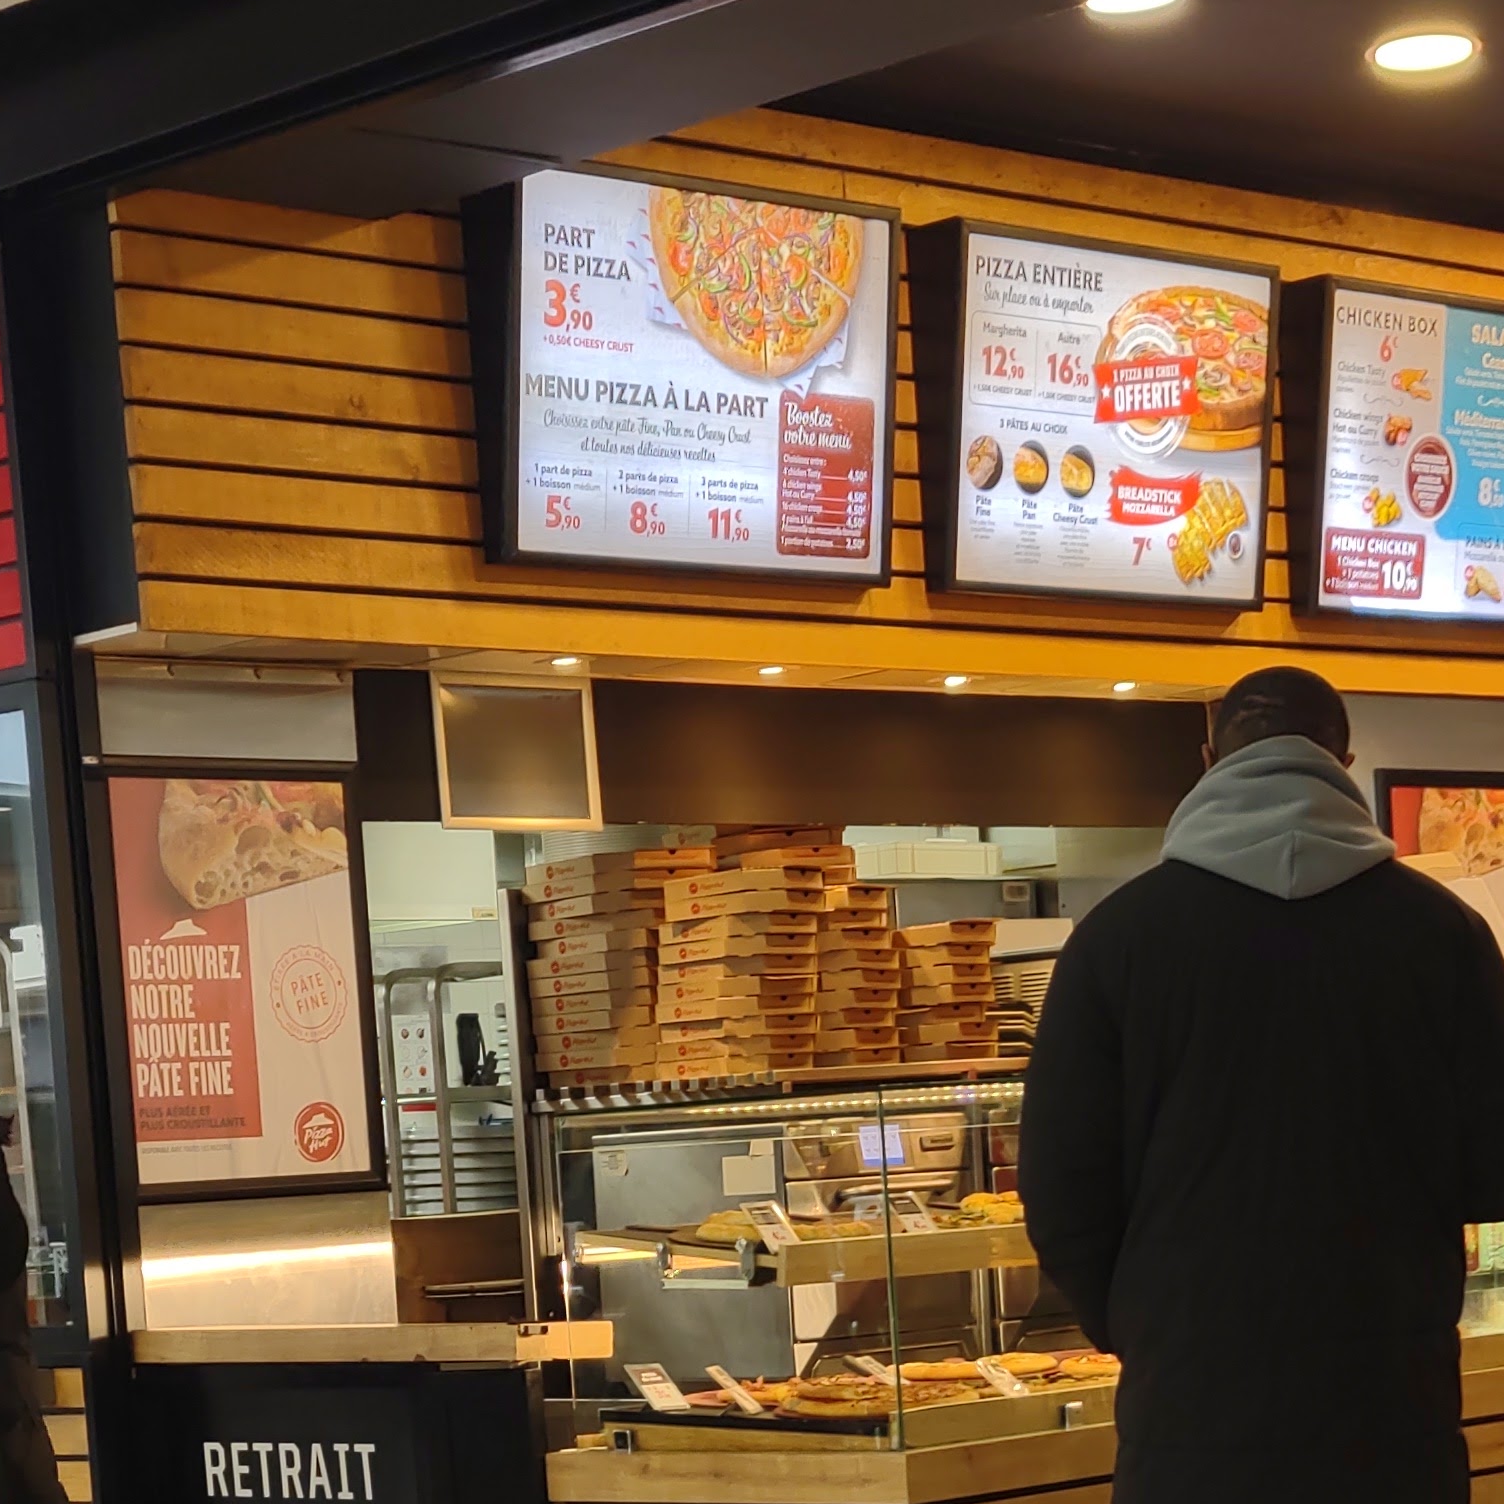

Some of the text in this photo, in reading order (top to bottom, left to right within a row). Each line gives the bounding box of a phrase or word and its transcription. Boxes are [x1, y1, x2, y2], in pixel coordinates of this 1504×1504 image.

[544, 223, 596, 249] PART
[544, 251, 631, 281] DE PIZZA
[975, 255, 1103, 293] PIZZA ENTIÈRE
[984, 281, 999, 302] Sur
[1001, 285, 1028, 308] place
[1029, 296, 1041, 307] ou
[982, 321, 1027, 339] Margherita
[1336, 306, 1438, 337] CHICKEN BOX
[573, 337, 605, 350] CHEESY
[607, 341, 634, 353] CRUST
[1057, 331, 1081, 346] Autre
[1119, 364, 1180, 383] PIZZA AU CHOIX
[1337, 361, 1365, 374] Chicken
[525, 373, 769, 418] MENU PIZZA À LA PART
[1113, 380, 1181, 413] OFFERTE
[784, 402, 832, 427] Boostez
[1333, 408, 1362, 420] Chicken
[544, 408, 588, 430] Choisissez
[590, 416, 614, 432] entre
[615, 417, 636, 436] pâte
[683, 426, 695, 438] ou
[697, 424, 726, 446] Cheesy
[728, 425, 751, 445] Crust
[1006, 416, 1029, 431] PÂTES
[1031, 420, 1042, 432] AU
[1043, 422, 1068, 435] CHOIX
[1332, 422, 1346, 432] Hot
[1359, 424, 1378, 437] Curry
[784, 423, 852, 450] votre menu
[580, 437, 716, 463] et toutes nos délicieuses recettes
[541, 464, 559, 478] part
[560, 465, 570, 476] de
[572, 467, 593, 480] pizza
[625, 470, 646, 484] parts
[647, 472, 658, 483] de
[659, 475, 679, 485] pizza
[1330, 468, 1358, 481] Chicken
[539, 478, 571, 490] boisson
[625, 485, 656, 497] boisson
[707, 477, 727, 490] parts
[729, 478, 739, 489] de
[740, 481, 759, 492] pizza
[708, 491, 737, 503] boisson
[975, 495, 992, 506] Pâte
[1021, 498, 1038, 510] Pâte
[1117, 486, 1182, 504] BREADSTICK
[975, 506, 992, 517] Fine
[1022, 509, 1036, 521] Pan
[1067, 502, 1084, 514] Pâte
[1122, 502, 1176, 516] MOZZARELLA
[1053, 512, 1098, 526] Cheesy Crust
[1331, 535, 1417, 556] MENU CHICKEN
[127, 938, 242, 981] DÉCOUVREZ
[290, 972, 325, 995] PÂTE
[130, 983, 195, 1020] NOTRE
[296, 990, 329, 1015] FINE
[133, 1022, 233, 1059] NOUVELLE
[136, 1056, 234, 1098] PÂTE FINE
[139, 1107, 163, 1118] PLUS
[199, 1105, 211, 1116] ET
[140, 1119, 165, 1131] PLUS
[304, 1127, 333, 1145] Pizza
[309, 1136, 332, 1154] Hut
[203, 1441, 376, 1501] RETRAIT
